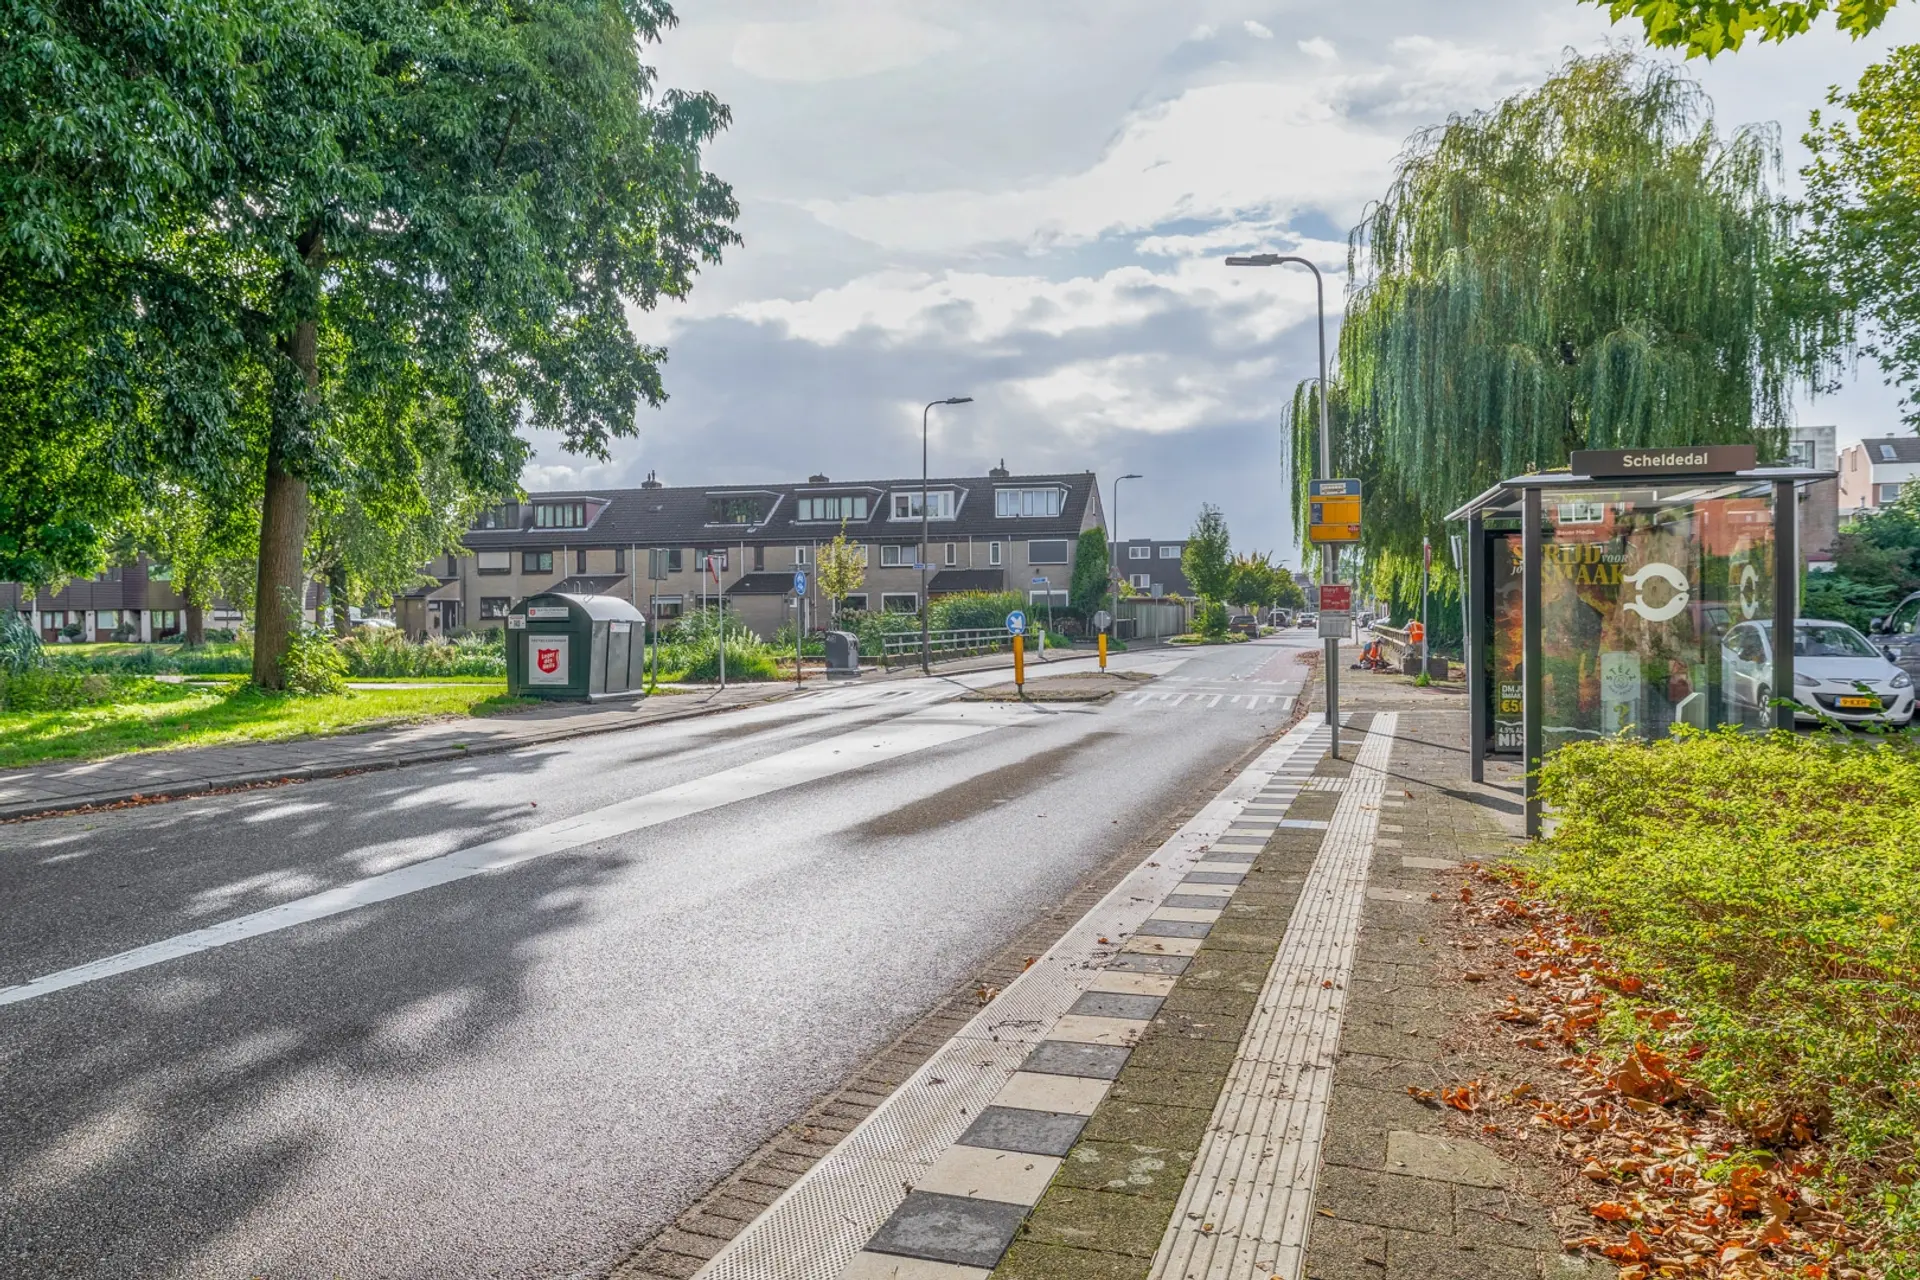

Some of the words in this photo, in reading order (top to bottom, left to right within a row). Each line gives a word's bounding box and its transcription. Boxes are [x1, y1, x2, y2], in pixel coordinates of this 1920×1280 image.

[1622, 452, 1708, 467] Scheldedal
[1512, 544, 1601, 566] SRIJD
[1602, 554, 1628, 563] VOOR
[1541, 564, 1624, 585] SMAAK
[541, 652, 555, 660] Leger
[1501, 700, 1524, 713] €50
[1498, 733, 1524, 747] NIX
